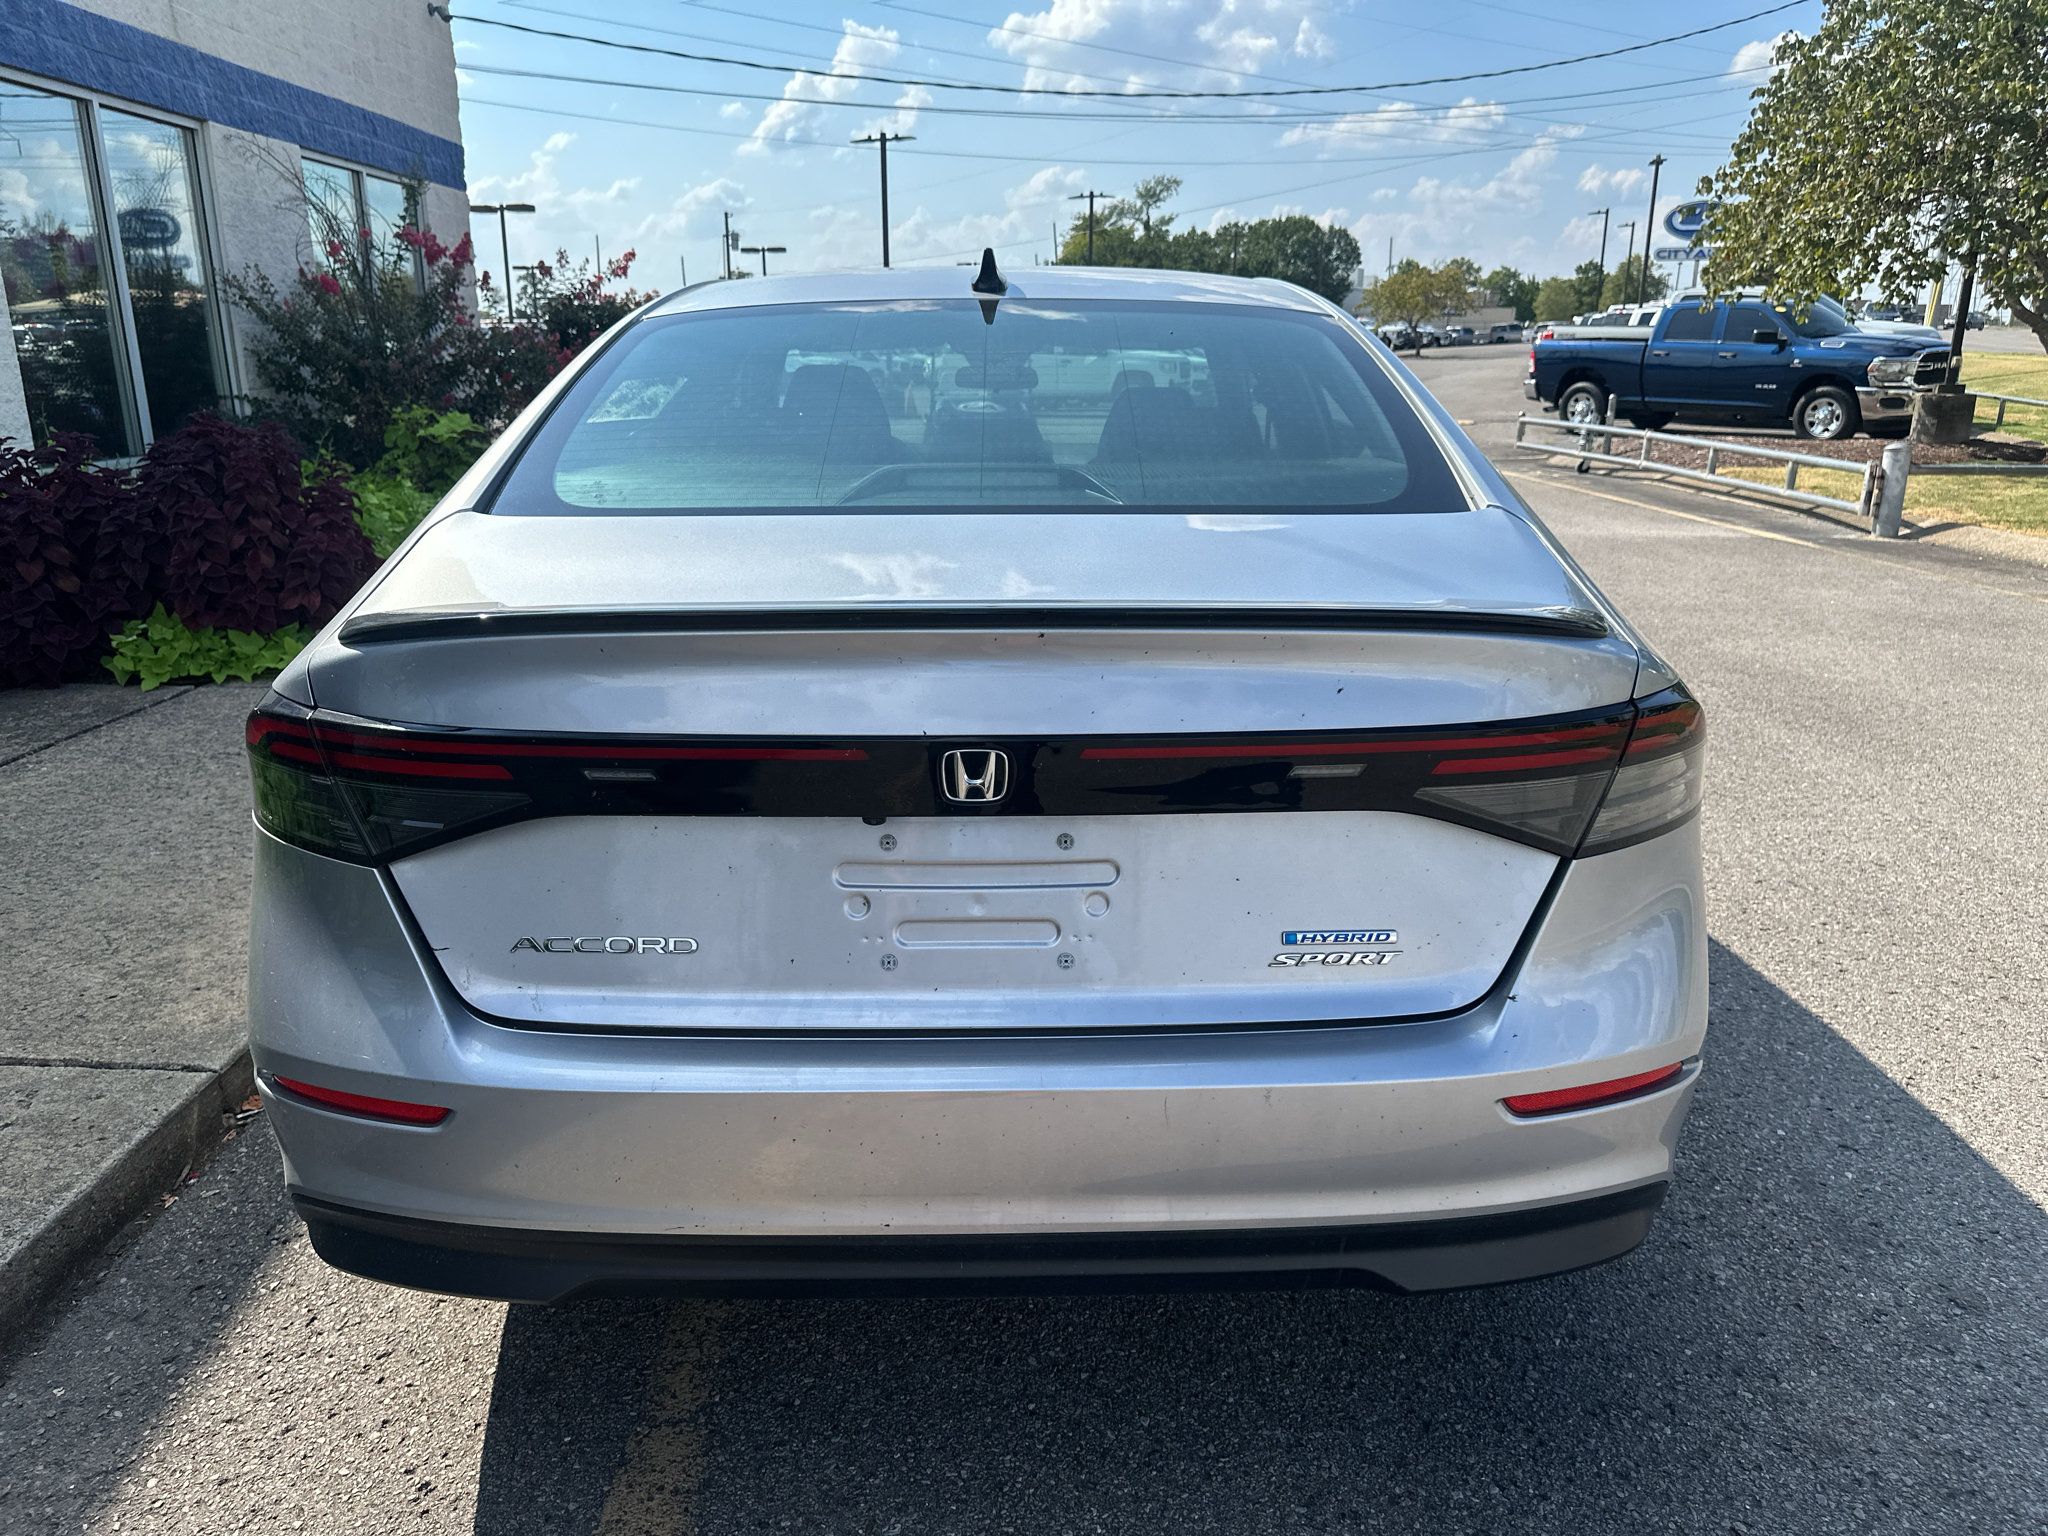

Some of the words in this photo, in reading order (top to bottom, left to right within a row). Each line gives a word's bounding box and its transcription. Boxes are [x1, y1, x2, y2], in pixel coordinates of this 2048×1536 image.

[510, 936, 698, 954] ACCORD
[1300, 932, 1391, 943] HYBRID
[1268, 950, 1403, 967] SPORT
